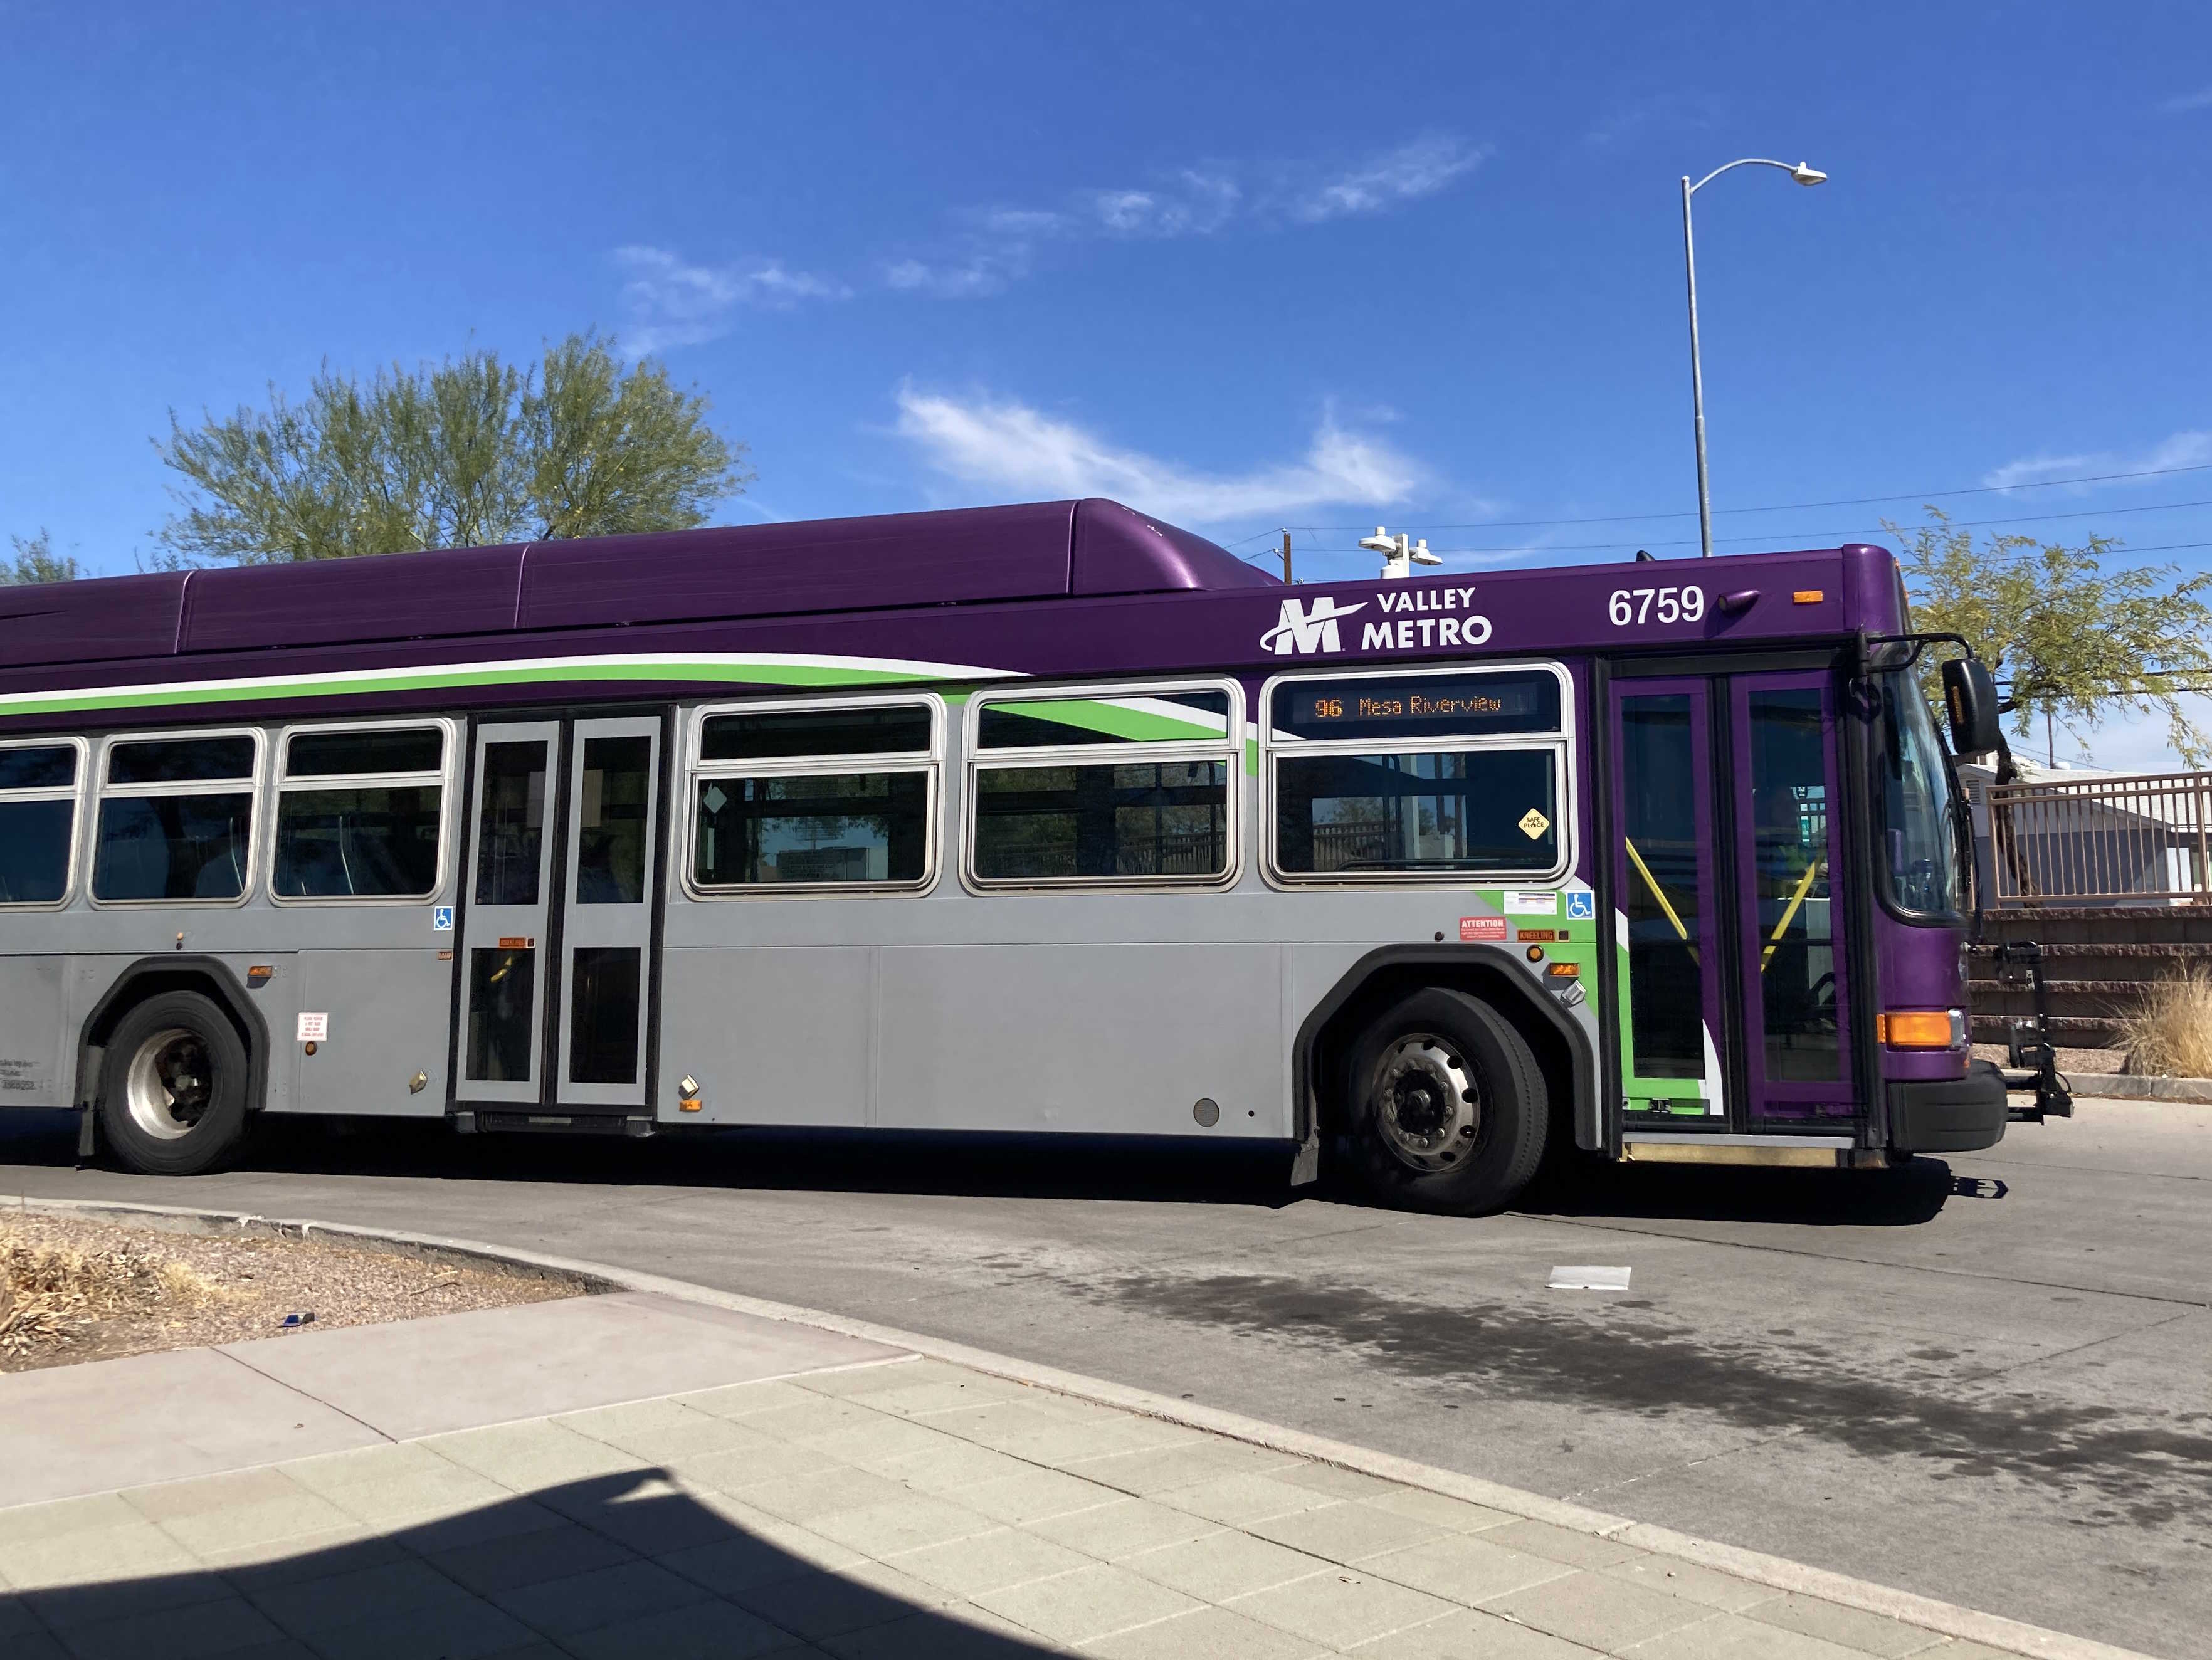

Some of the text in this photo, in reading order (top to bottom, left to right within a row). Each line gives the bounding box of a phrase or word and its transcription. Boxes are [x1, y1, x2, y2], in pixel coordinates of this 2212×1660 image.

[1376, 587, 1476, 613] VALLEY
[1609, 586, 1704, 626] 6759
[1361, 615, 1492, 651] METRO
[1315, 696, 1501, 717] 96 Mesa Riverview
[1462, 919, 1504, 928] ATTENTION
[1519, 931, 1554, 940] KNEELING
